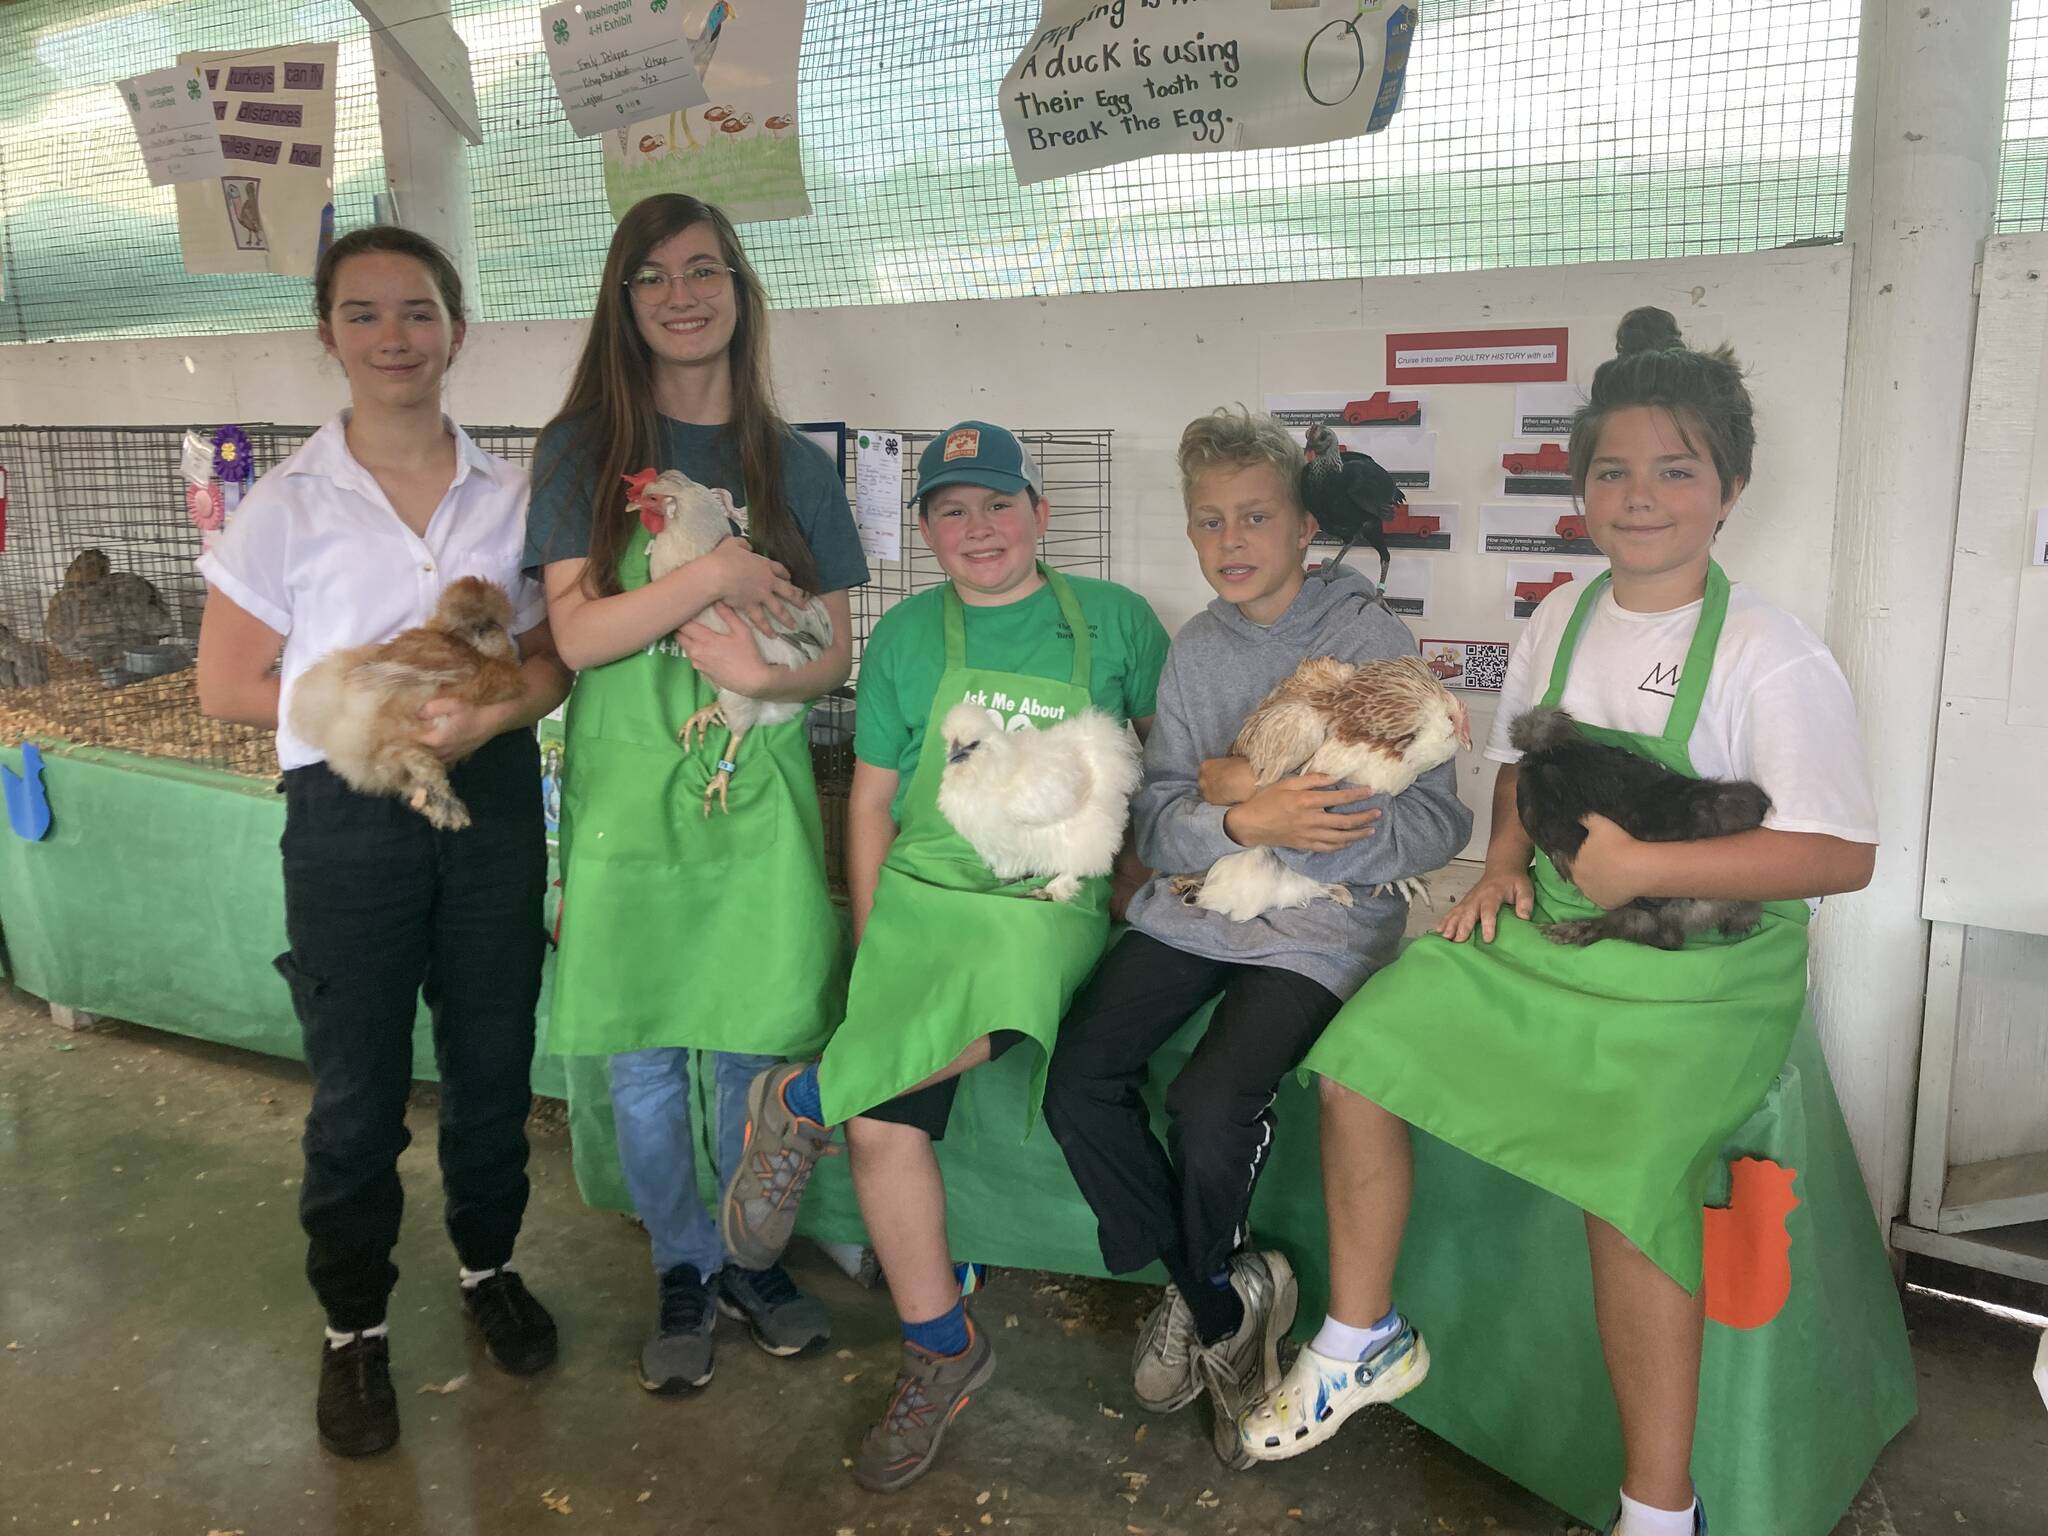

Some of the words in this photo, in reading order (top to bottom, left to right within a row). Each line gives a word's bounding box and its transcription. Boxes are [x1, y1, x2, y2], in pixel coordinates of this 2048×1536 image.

[583, 0, 633, 21] Washington
[603, 14, 633, 32] Exhibit
[1020, 53, 1037, 79] A
[1133, 38, 1151, 67] is
[1162, 31, 1240, 73] using
[229, 69, 275, 89] turkeys
[287, 68, 307, 82] can
[1096, 89, 1133, 117] Egg
[1143, 73, 1199, 100] tooth
[1210, 70, 1238, 89] to
[239, 101, 303, 125] distances
[1120, 114, 1161, 135] the
[1173, 108, 1233, 144] Egg.
[254, 143, 281, 161] per
[1397, 356, 1419, 365] Cruise
[1421, 356, 1433, 364] into
[1454, 353, 1490, 362] POULTRY
[1491, 352, 1526, 361] HISTORY
[1527, 351, 1541, 359] with
[963, 690, 988, 707] Ask
[991, 692, 1016, 712] Me
[1019, 697, 1065, 720] About
